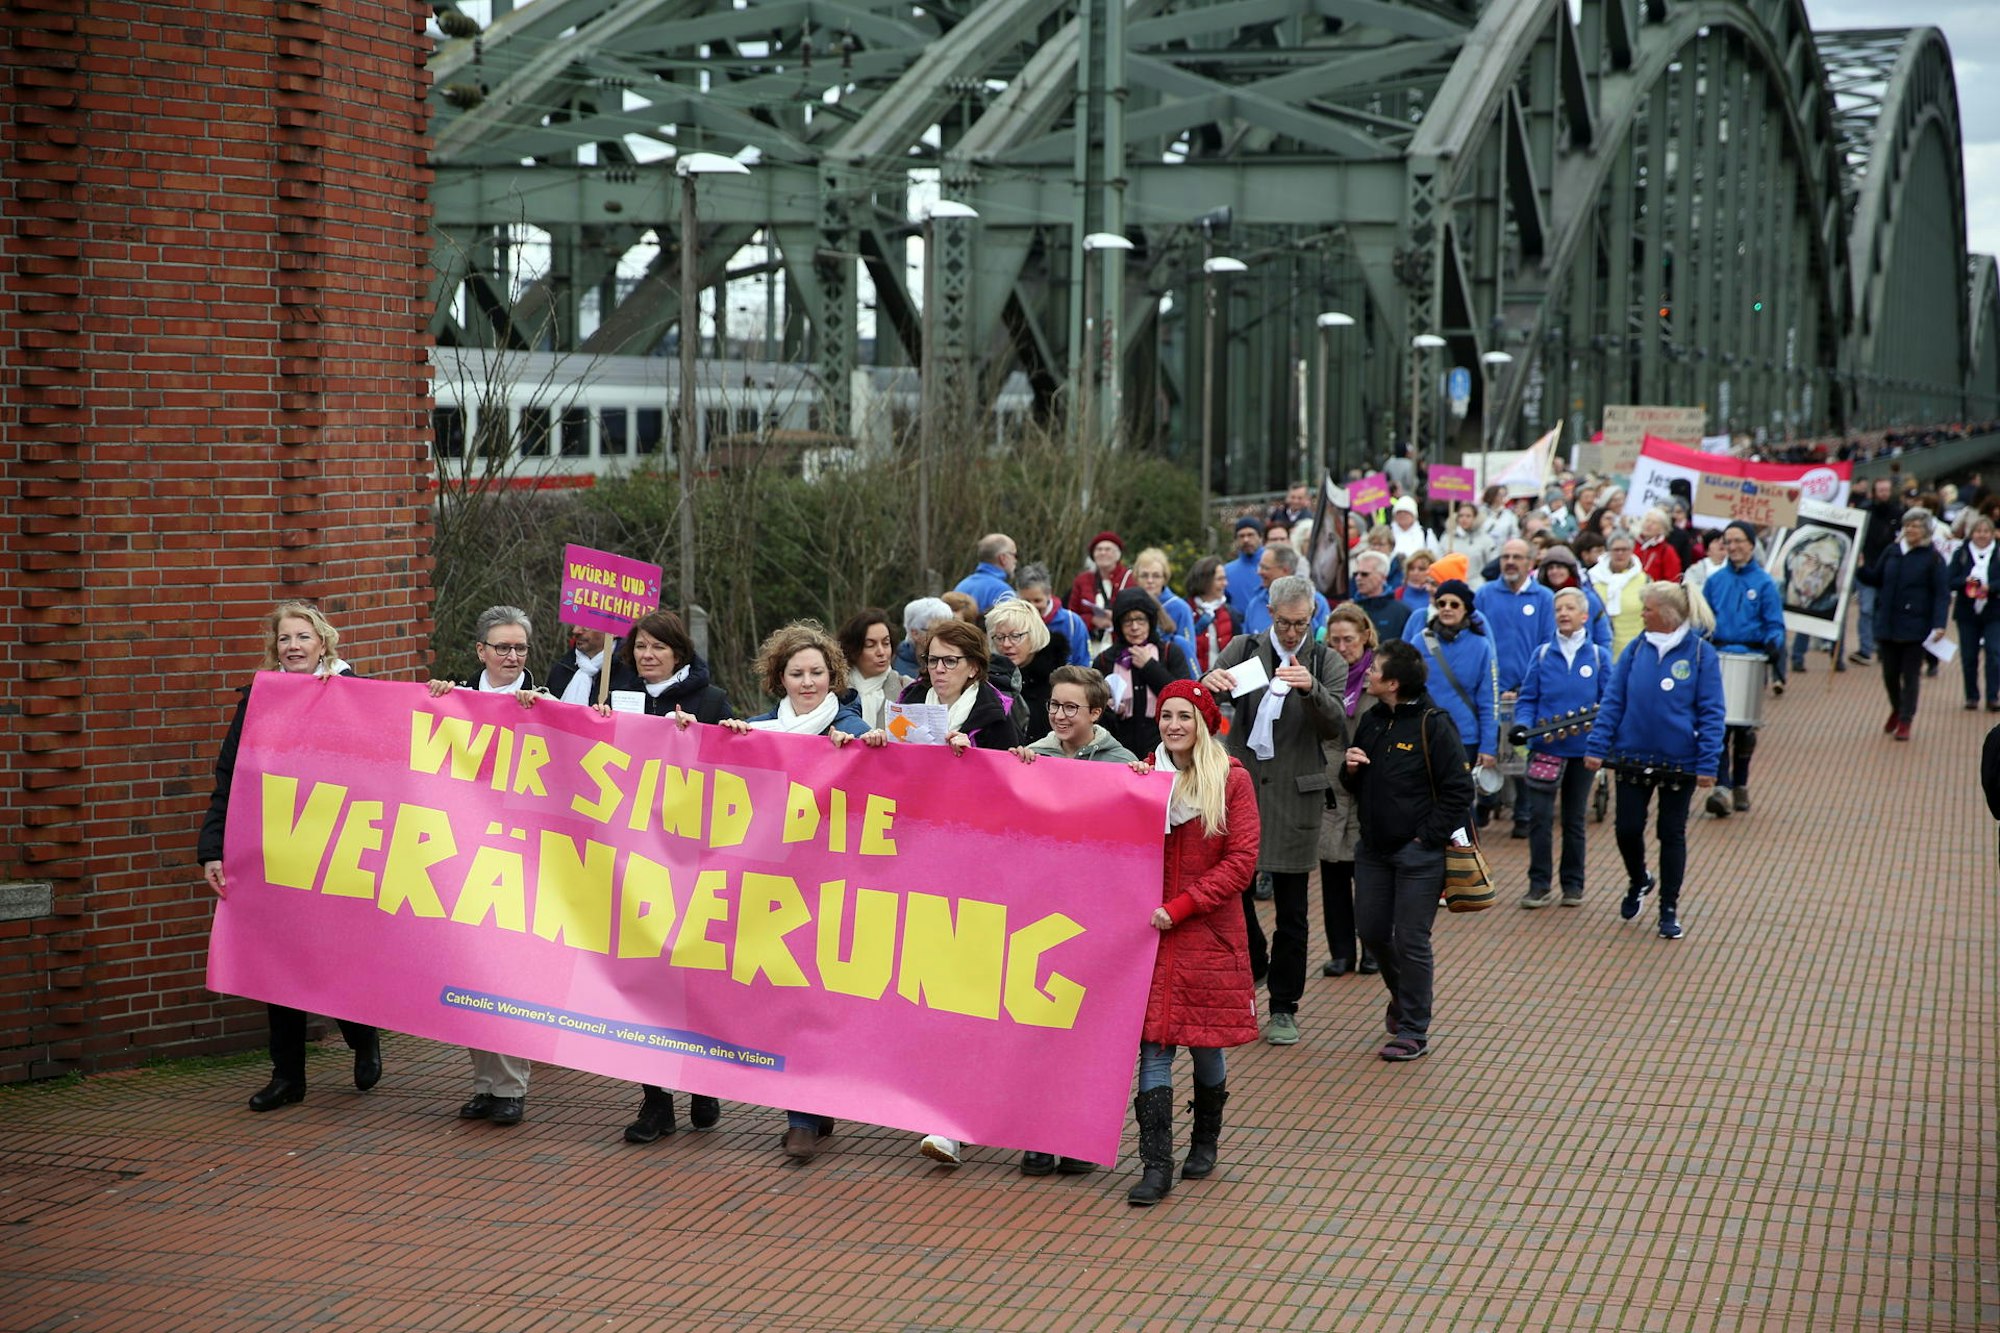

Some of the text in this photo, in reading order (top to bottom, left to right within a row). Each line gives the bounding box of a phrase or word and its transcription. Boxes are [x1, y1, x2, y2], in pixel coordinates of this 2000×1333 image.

[1729, 503, 1776, 524] SEELE
[569, 563, 646, 596] WÜRDE UND
[411, 712, 897, 856] WIR SIND DIE
[261, 772, 1086, 1029] VERÄNDERUNG
[446, 991, 494, 1010] Catholic
[497, 1001, 555, 1023] Women's
[558, 1015, 607, 1035] Council
[615, 1028, 646, 1042] viele
[647, 1034, 707, 1056] Stimmen,
[709, 1045, 735, 1059] eine
[737, 1050, 775, 1066] Vision
